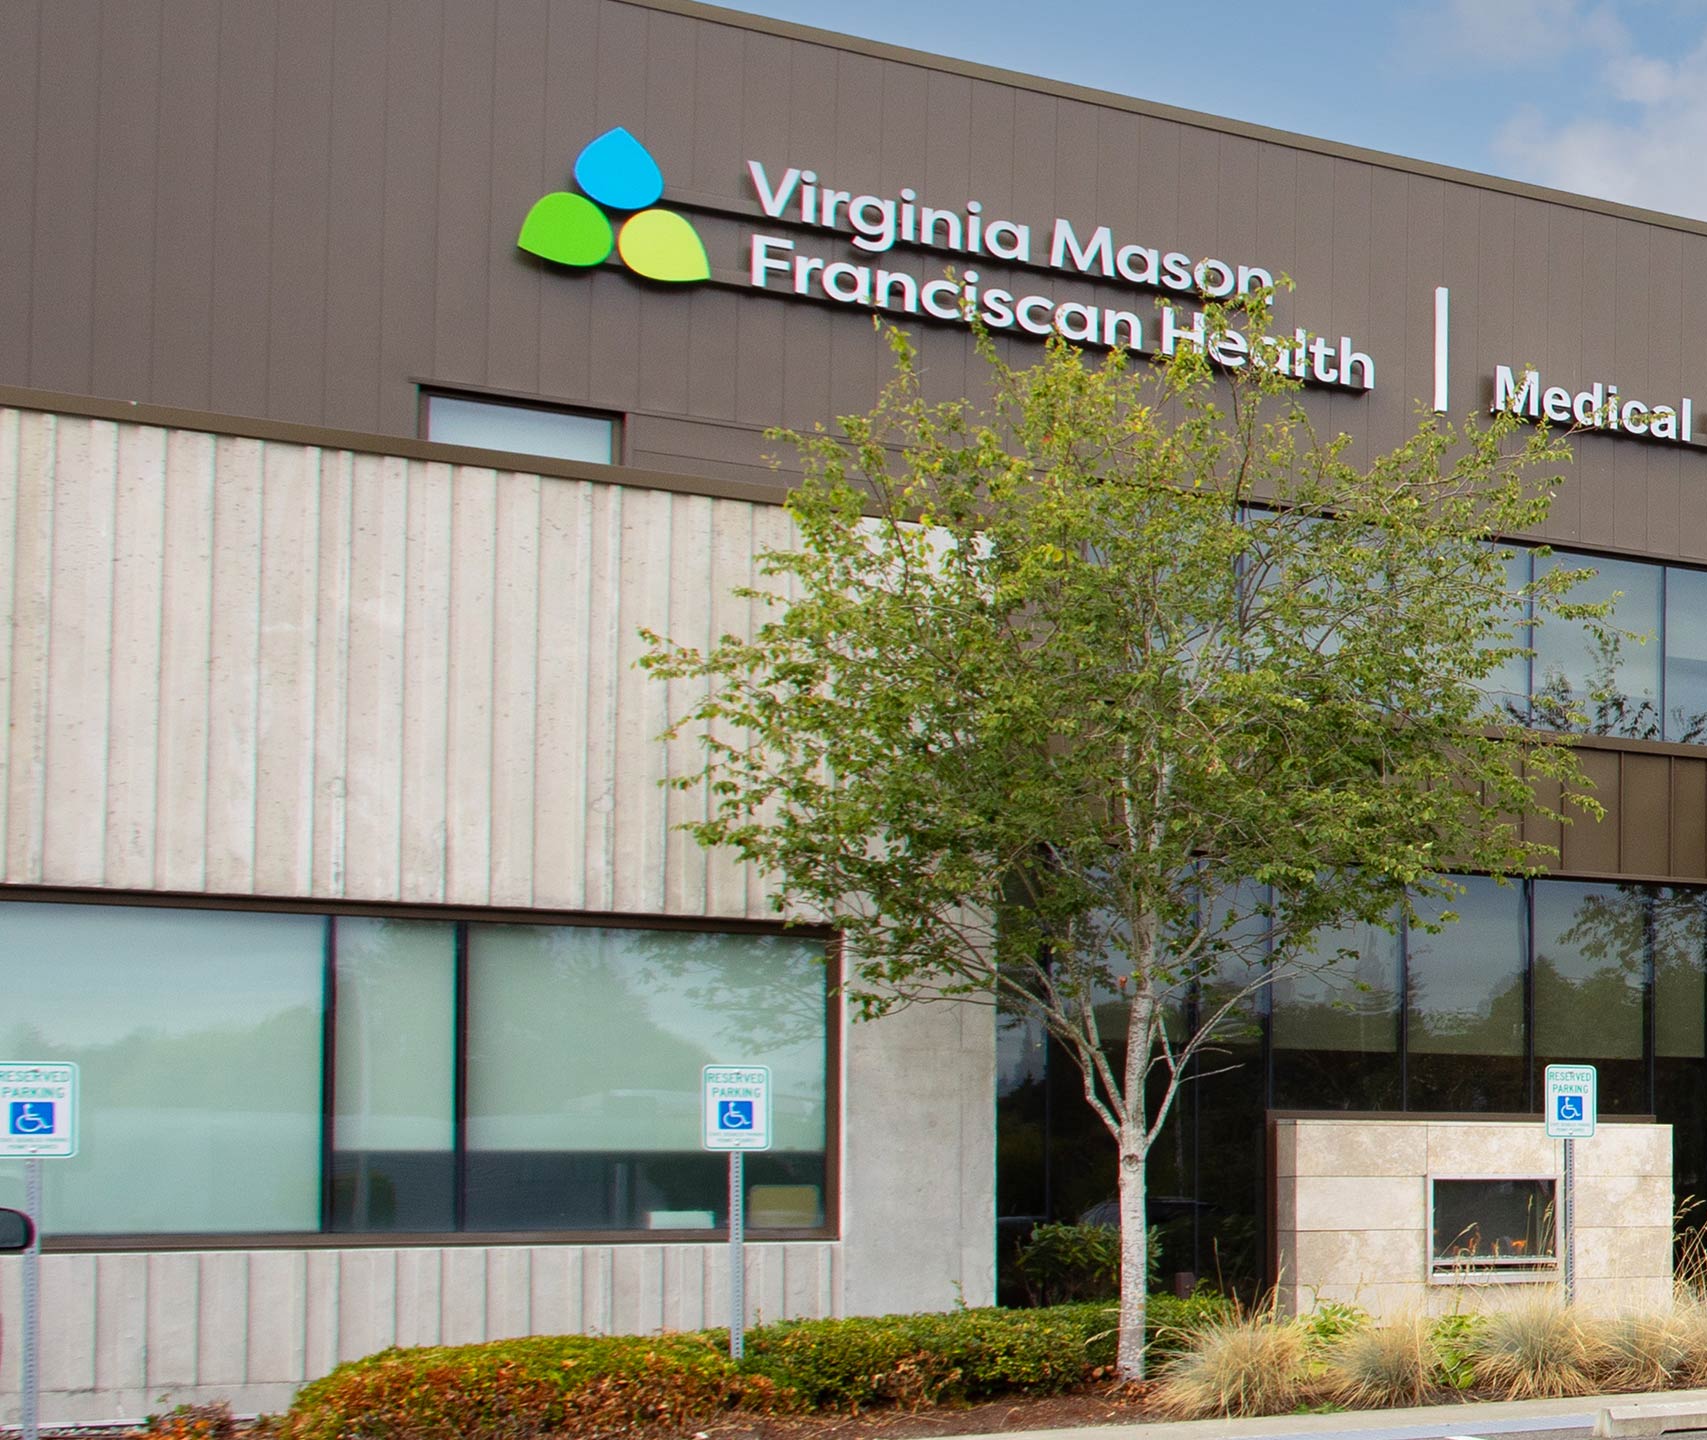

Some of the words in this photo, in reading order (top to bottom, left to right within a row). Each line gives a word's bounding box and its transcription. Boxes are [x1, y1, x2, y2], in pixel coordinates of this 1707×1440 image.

[747, 160, 1030, 262] Virginia
[1050, 218, 1274, 306] Mason
[751, 234, 1143, 351] Franciscan
[1495, 365, 1692, 442] Medical
[707, 1072, 765, 1084] RESERVED
[1548, 1071, 1592, 1082] RESERVED
[2, 1086, 65, 1099] PARKING
[711, 1087, 761, 1098] PARKING
[1552, 1084, 1589, 1094] PARKING
